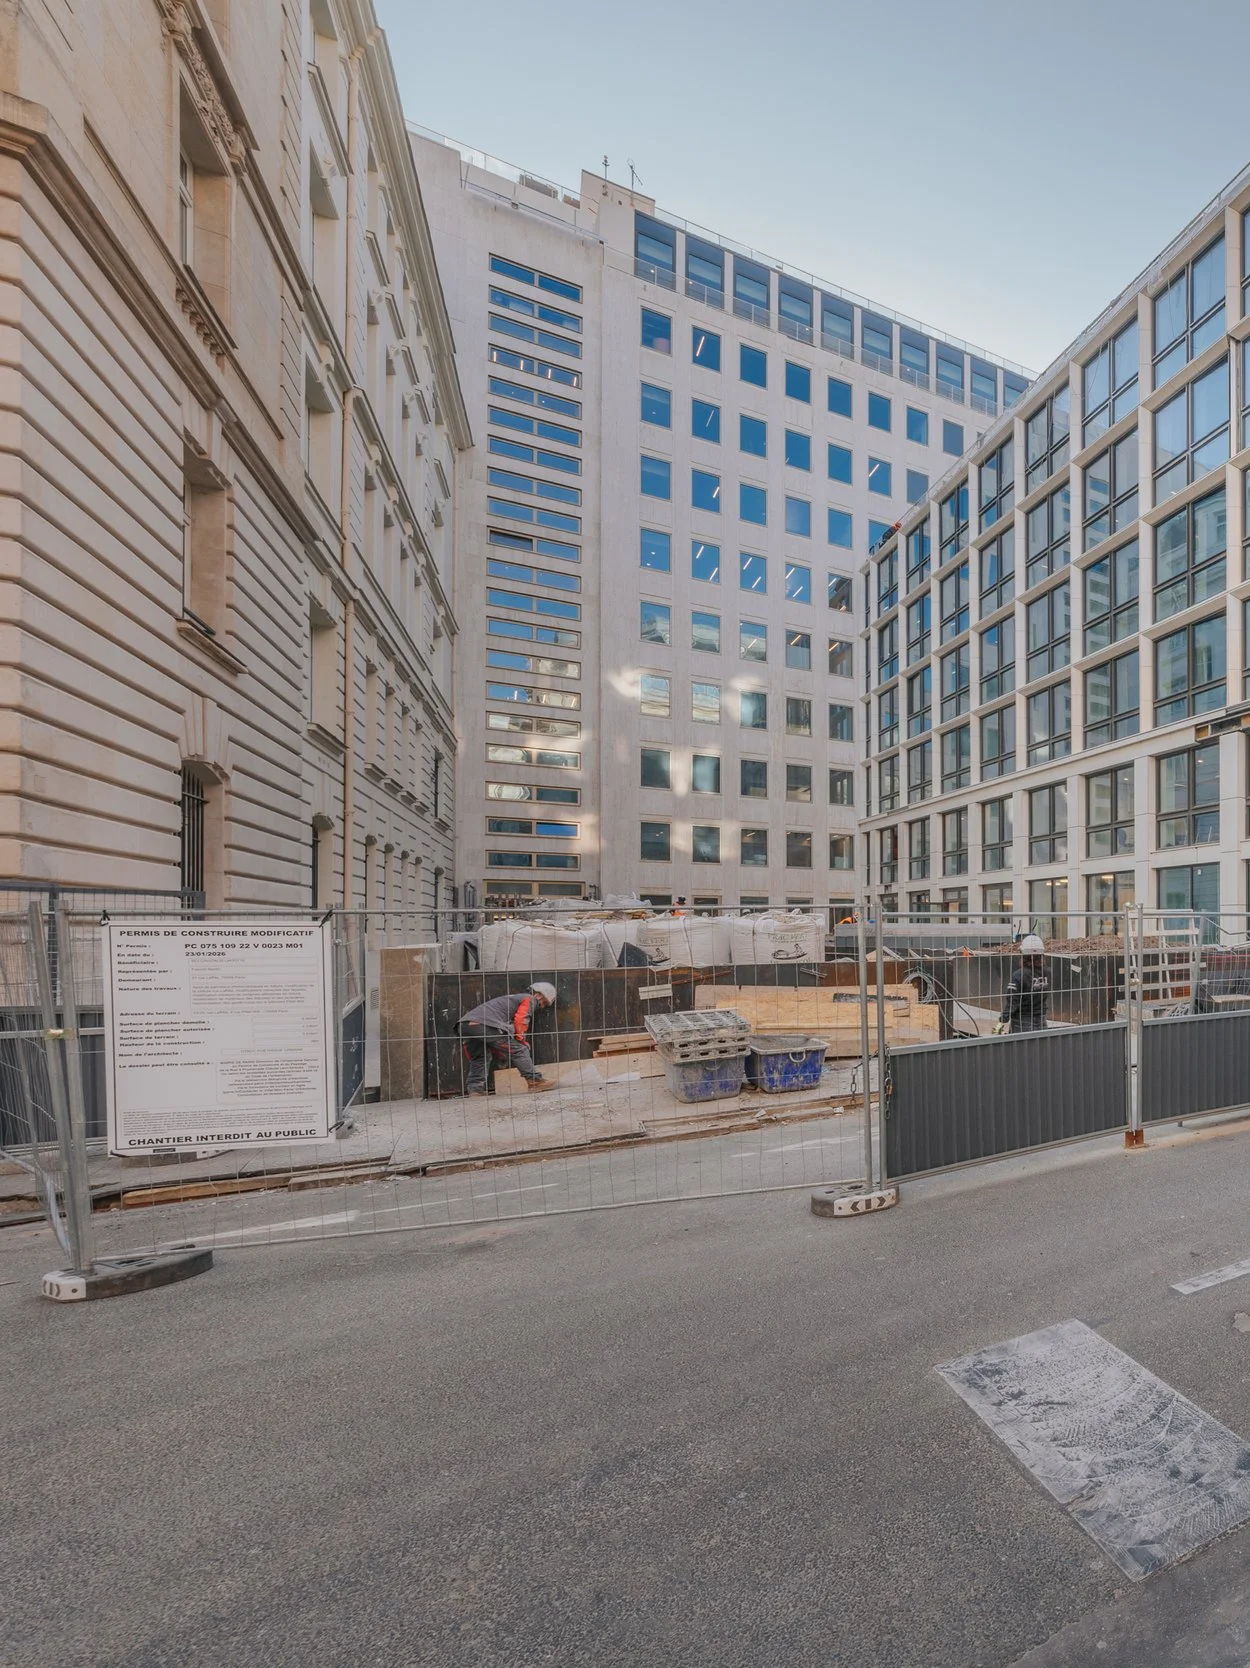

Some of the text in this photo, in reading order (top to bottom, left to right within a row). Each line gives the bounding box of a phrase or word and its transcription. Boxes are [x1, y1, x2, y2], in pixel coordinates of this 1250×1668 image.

[128, 1128, 317, 1147] CHANTIER INTERDIT AU PUBLIC
